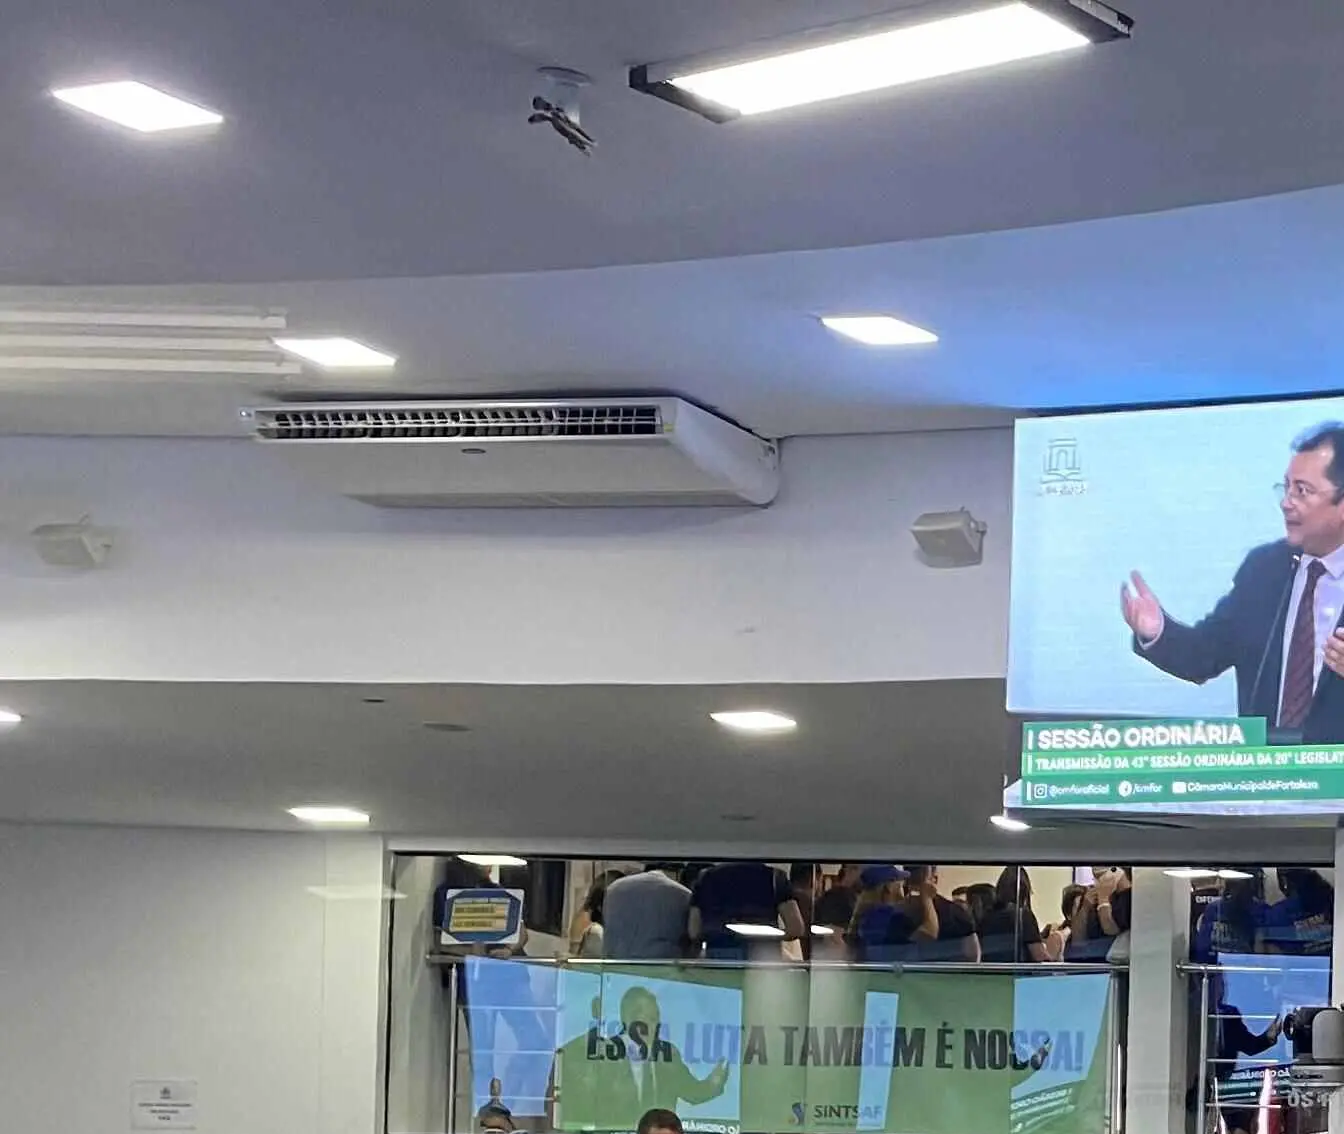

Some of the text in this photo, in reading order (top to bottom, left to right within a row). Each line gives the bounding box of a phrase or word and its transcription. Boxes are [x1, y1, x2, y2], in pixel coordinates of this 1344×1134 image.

[1037, 719, 1245, 749] SESSÃO ORDINÁRIA
[1036, 754, 1111, 771] TRANSMISSÃO
[1114, 756, 1129, 769] DA
[1150, 752, 1191, 768] SESSÃO
[1193, 750, 1254, 767] ORDINÁRIA
[1257, 753, 1272, 765] DA
[587, 1020, 1086, 1072] ESSA LUTA TAMBÉM É NOSSA!
[814, 1104, 884, 1121] SINTSAF
